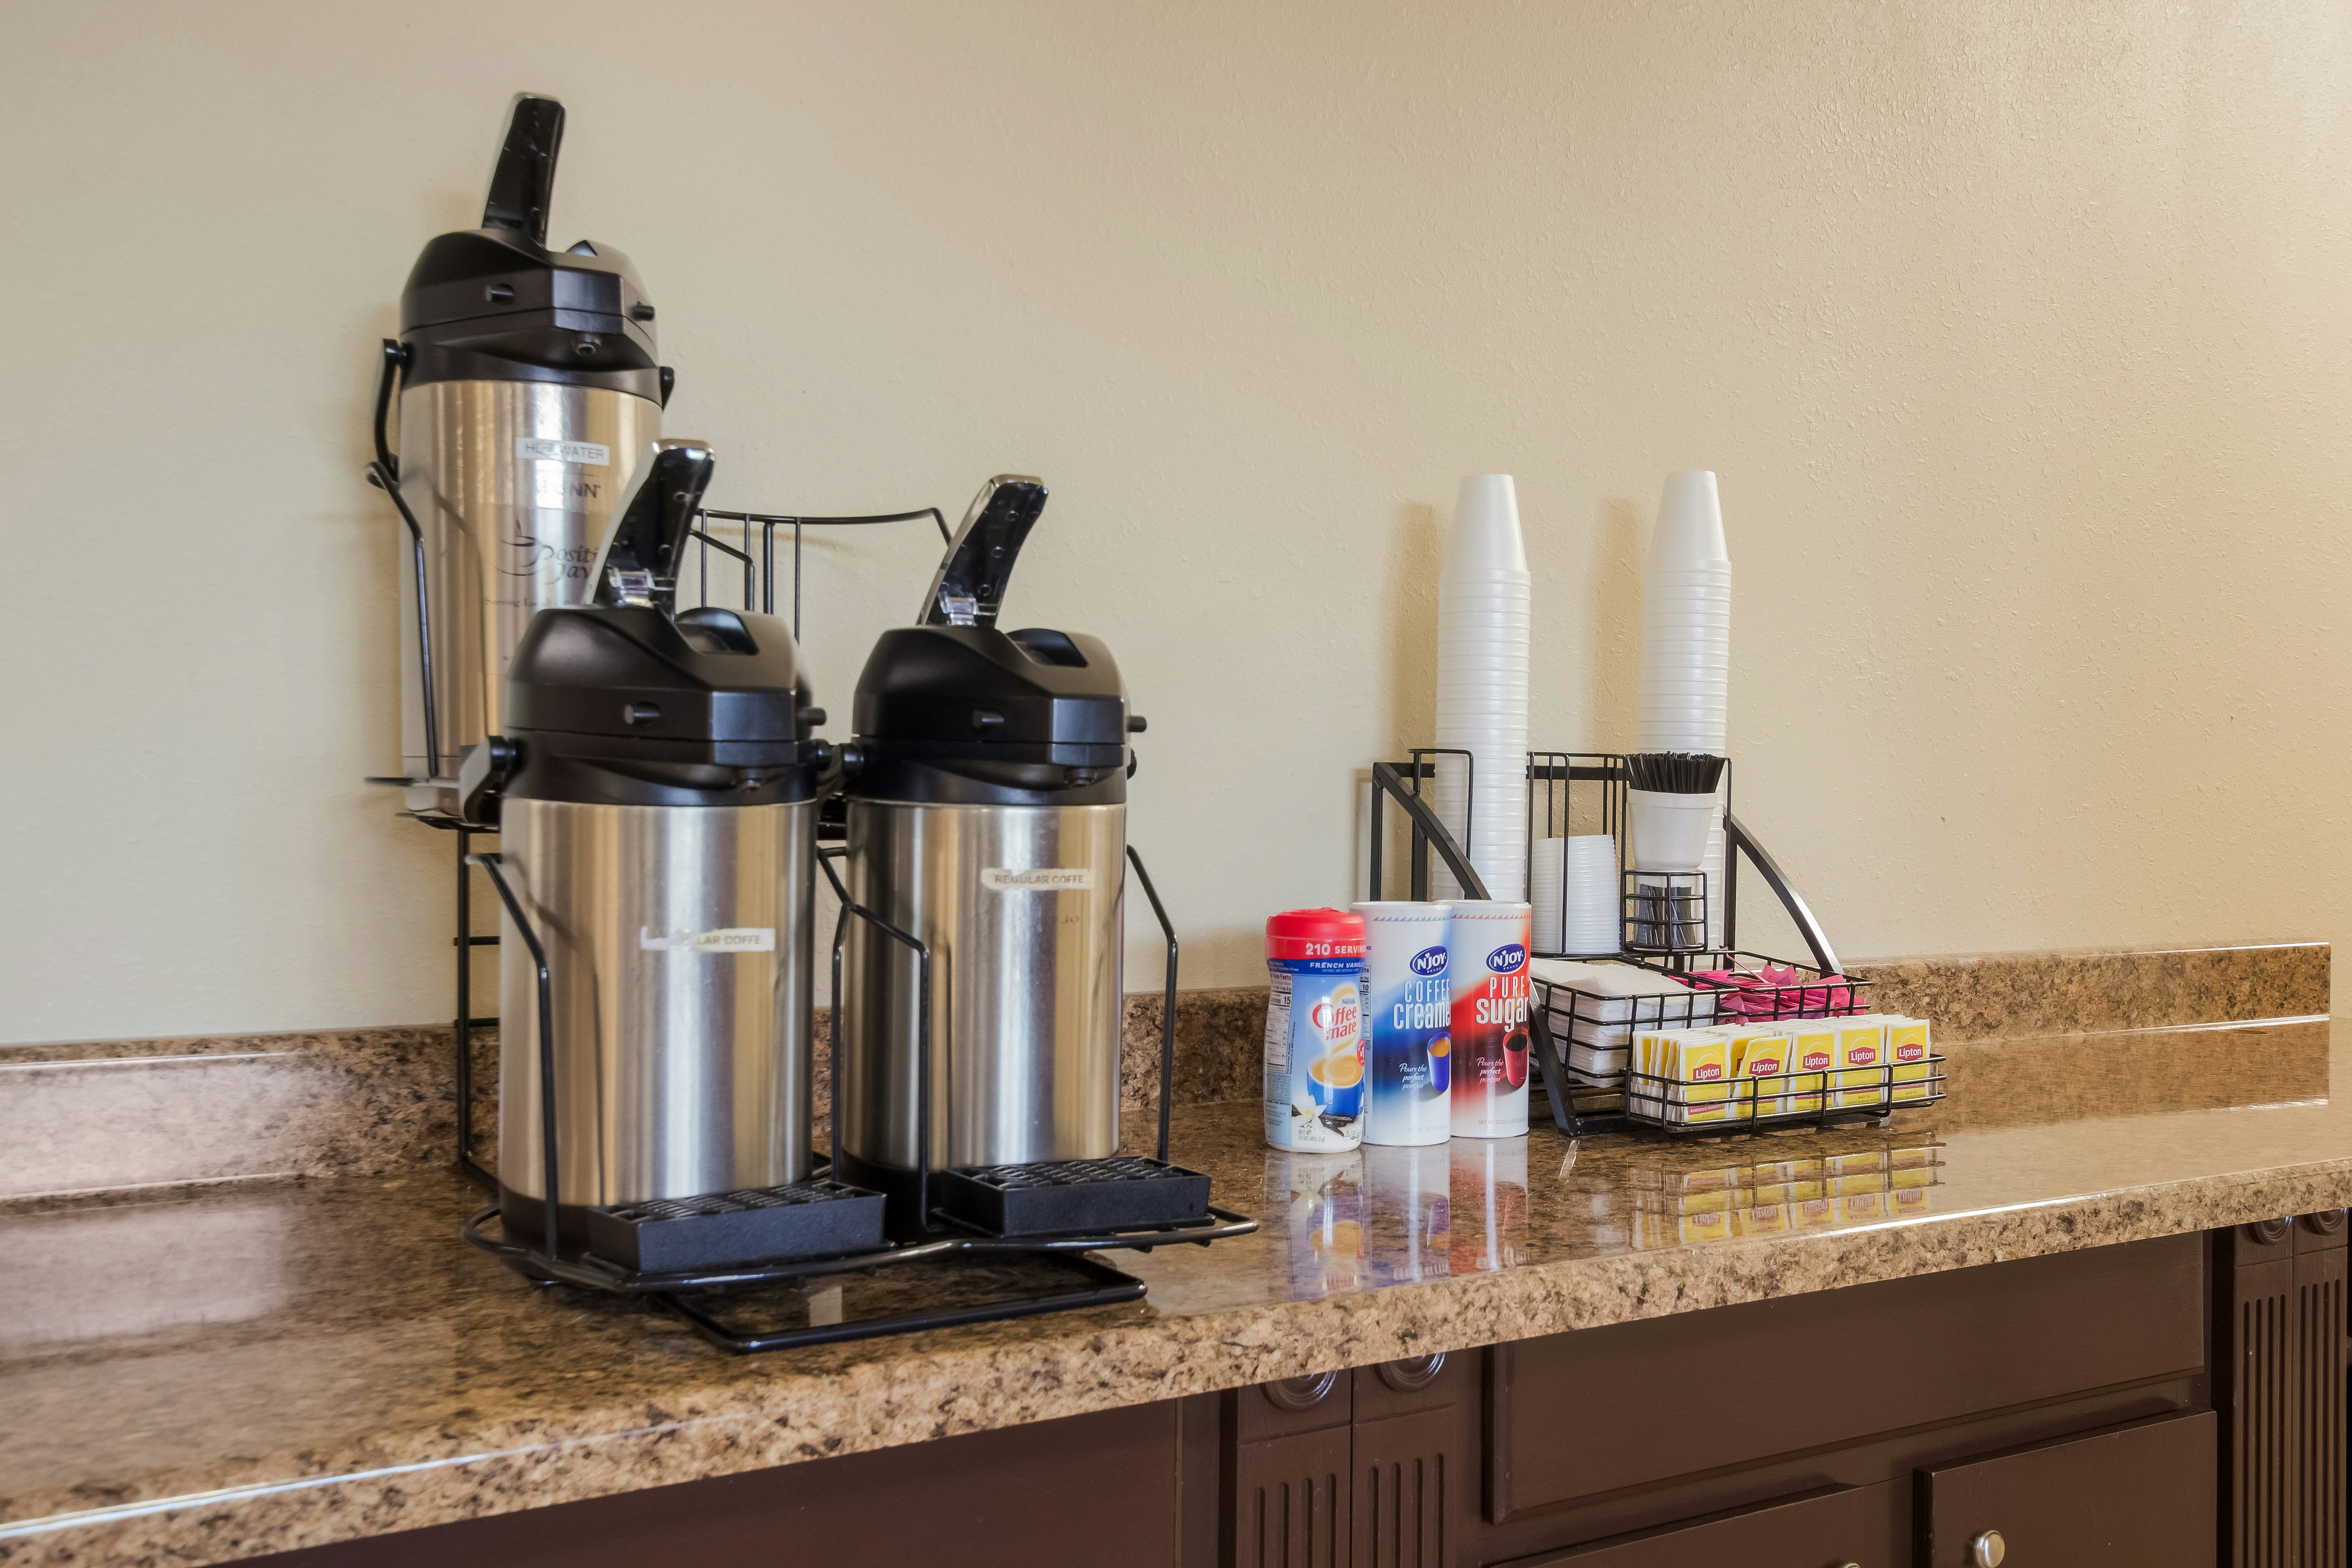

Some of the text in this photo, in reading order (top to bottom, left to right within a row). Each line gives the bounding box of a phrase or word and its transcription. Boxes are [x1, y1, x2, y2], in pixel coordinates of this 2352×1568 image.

[994, 875, 1084, 884] REGULAR COFFE
[725, 935, 762, 945] COFFE
[1306, 943, 1330, 955] 210
[1404, 978, 1449, 1002] COFFEE
[1489, 976, 1525, 998] PURE
[1284, 996, 1291, 1005] 15
[1475, 996, 1529, 1032] sugar
[1326, 1021, 1357, 1041] mate
[1851, 1052, 1874, 1062] Lipton
[1899, 1048, 1921, 1059] Lipton
[1477, 1057, 1504, 1067] Pours the
[1805, 1057, 1828, 1067] Lipton
[1399, 1063, 1427, 1072] Pours the
[1479, 1066, 1501, 1077] perfect
[1752, 1063, 1777, 1073] Lipton
[1402, 1072, 1424, 1083] perfect
[1695, 1068, 1720, 1080] Lipton
[1479, 1076, 1501, 1084] portion
[1402, 1082, 1424, 1091] portion
